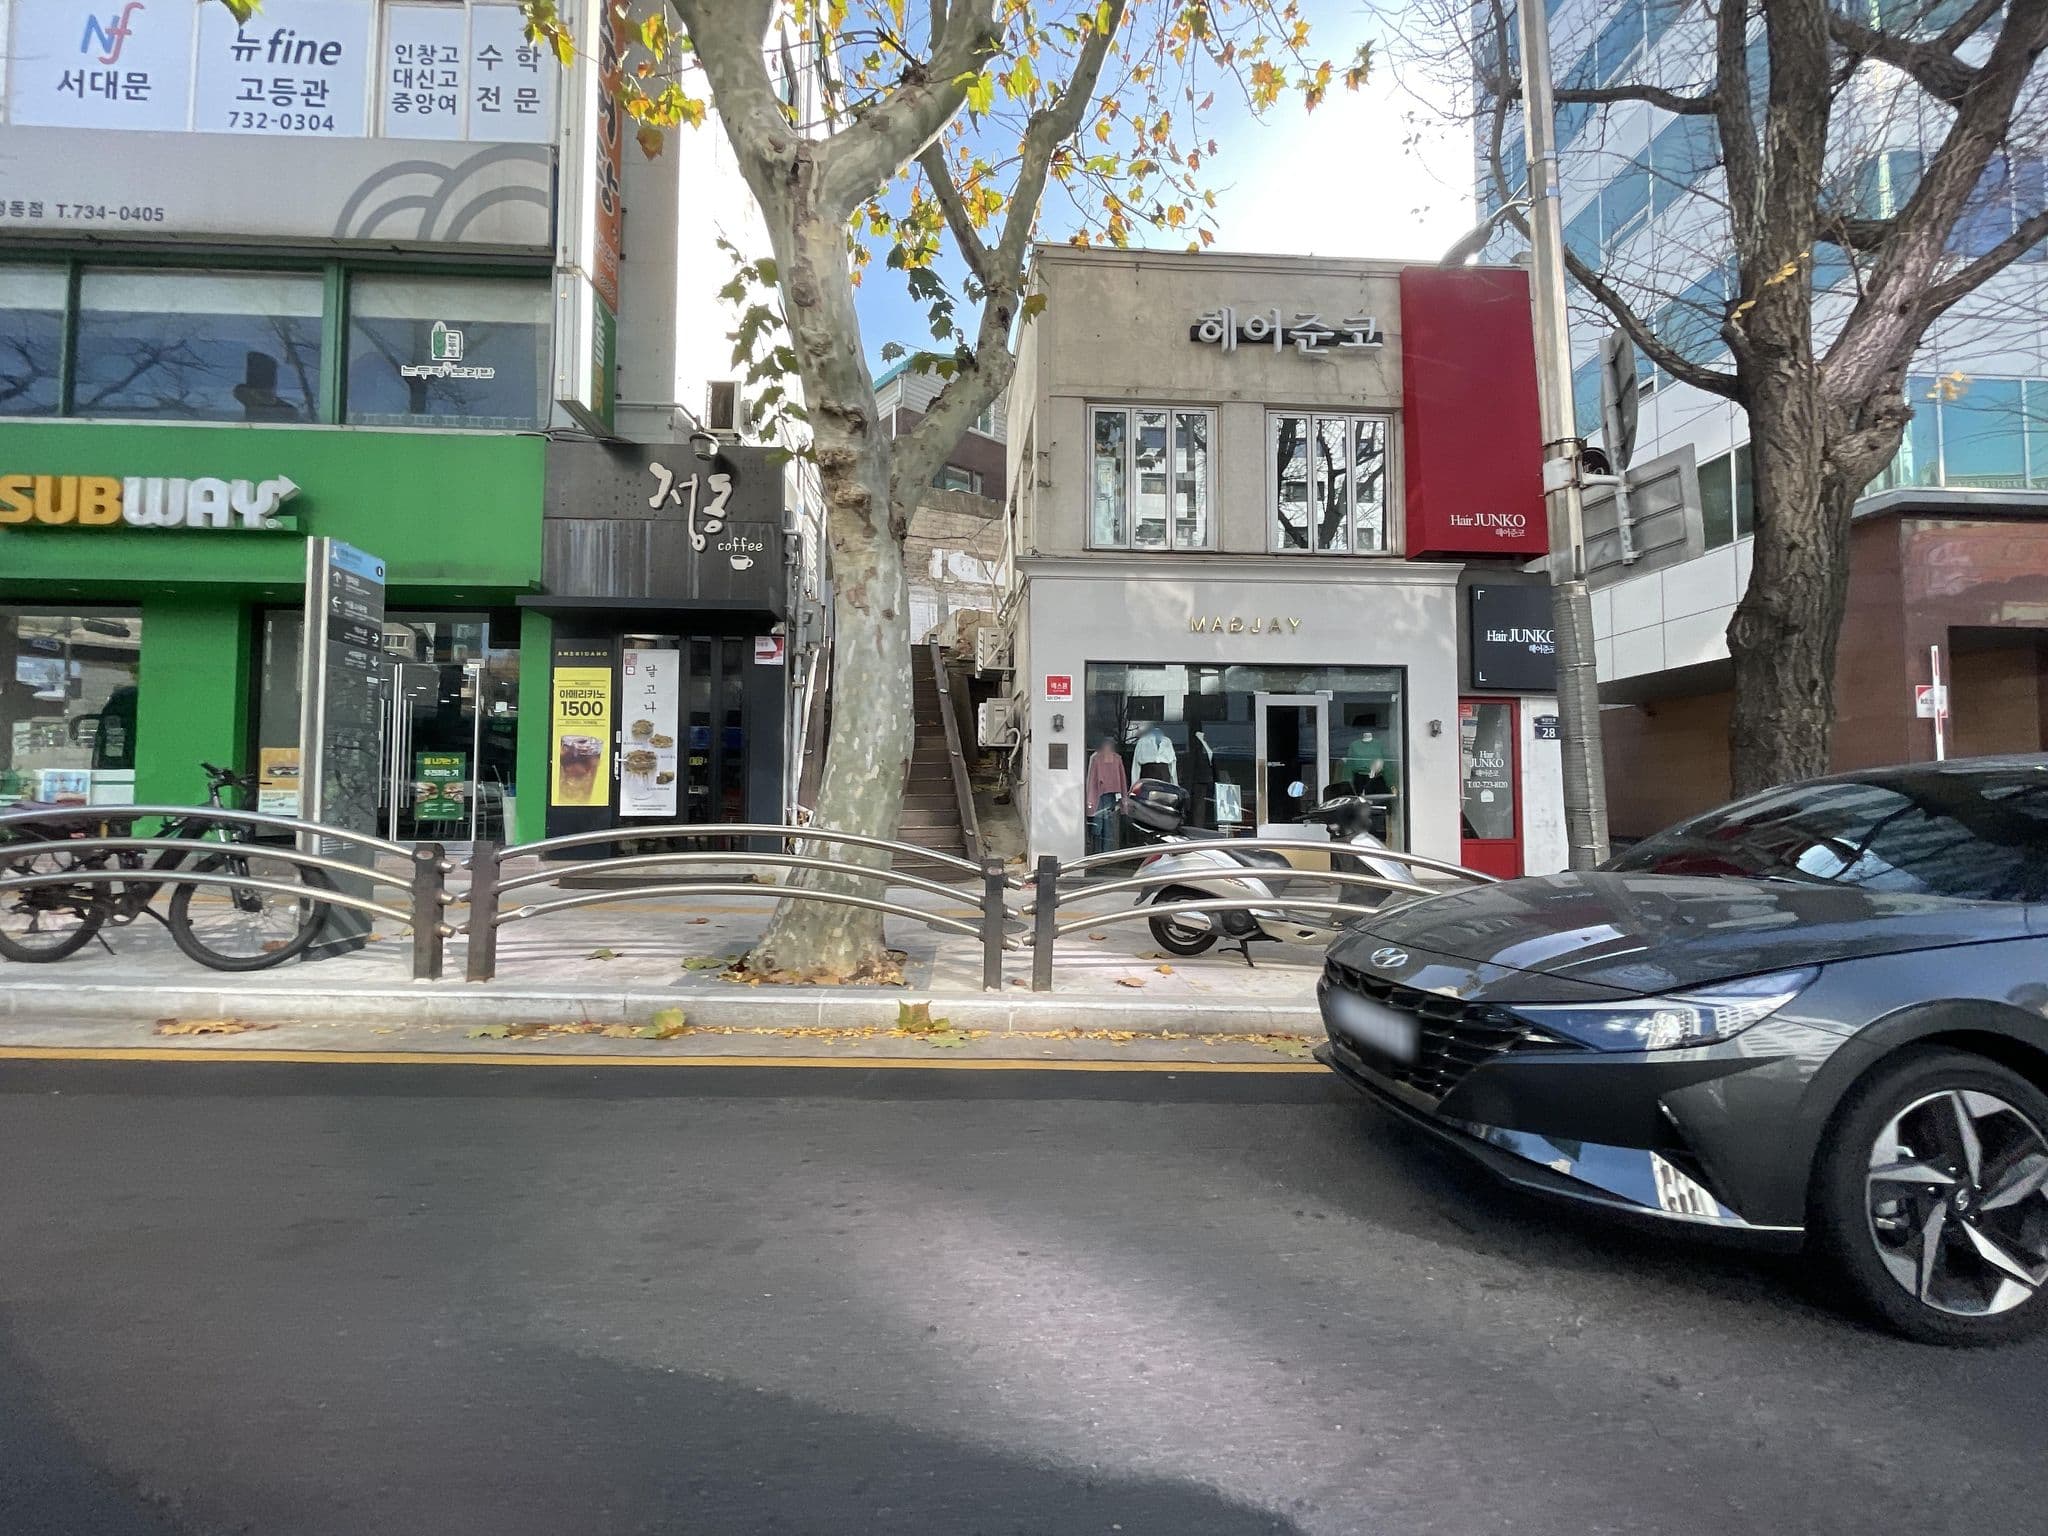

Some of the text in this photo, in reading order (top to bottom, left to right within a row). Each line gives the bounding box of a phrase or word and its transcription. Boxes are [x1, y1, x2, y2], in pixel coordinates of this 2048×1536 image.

[394, 43, 460, 66] 인창고
[57, 69, 152, 101] 서대문
[393, 67, 459, 90] 대신고
[235, 77, 330, 108] 고등관
[391, 92, 457, 116] 중앙여
[228, 111, 335, 132] 732-0304
[1196, 303, 1384, 355] 헤어준코
[0, 473, 301, 530] SUBWAY
[1449, 512, 1526, 527] Hair JUNKO
[717, 536, 765, 552] coffee
[1486, 629, 1508, 642] Hair
[559, 689, 606, 699] 아메리카노
[560, 701, 604, 717] 1500
[1542, 727, 1556, 739] 28
[1470, 758, 1504, 768] JUNKO
